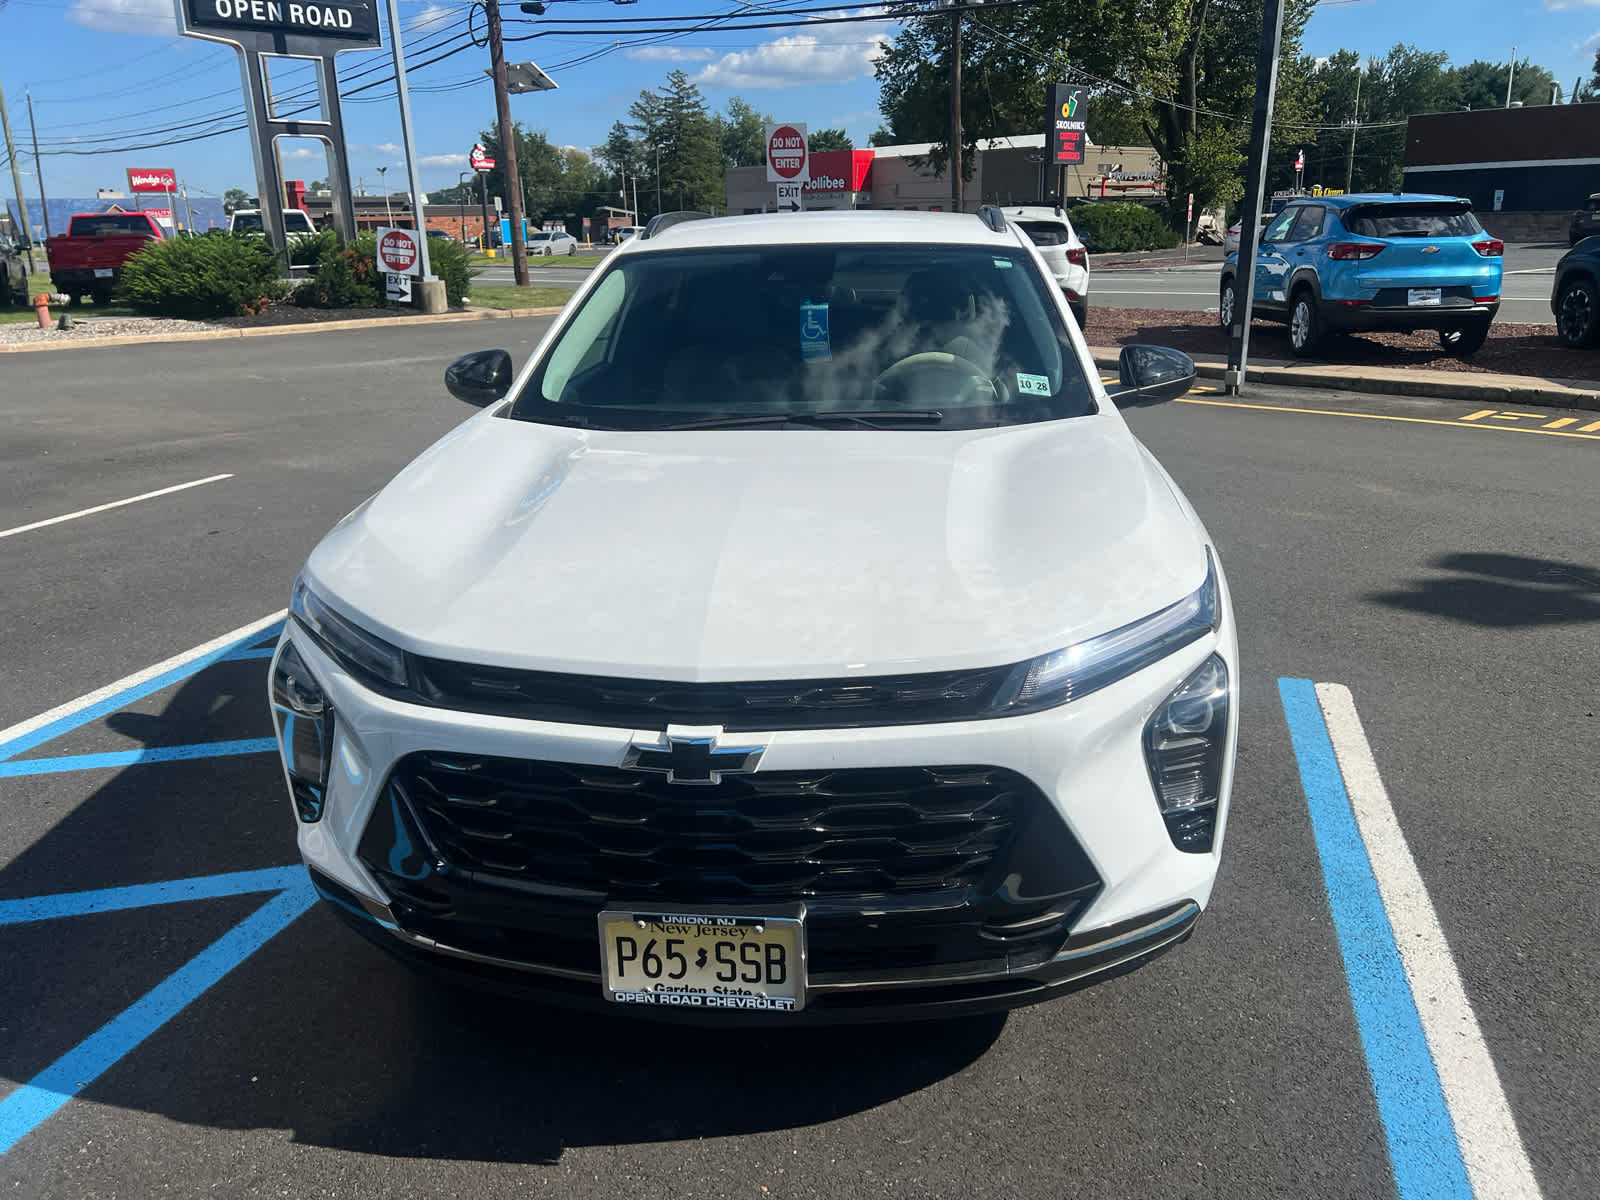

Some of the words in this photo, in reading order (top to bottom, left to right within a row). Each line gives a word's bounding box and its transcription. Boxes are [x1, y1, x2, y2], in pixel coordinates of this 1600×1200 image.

[215, 0, 283, 22] OPEN
[289, 3, 353, 28] ROAD
[1055, 120, 1086, 130] SKOLNIKS
[773, 137, 783, 147] DO
[786, 137, 801, 148] NOT
[775, 158, 801, 169] ENTER
[804, 175, 845, 190] Jollibee
[779, 187, 799, 198] EXIT
[383, 238, 395, 247] DO
[396, 239, 412, 249] NOT
[385, 254, 411, 265] ENTER
[388, 275, 409, 286] EXIT
[1020, 380, 1032, 389] 10
[1036, 382, 1048, 391] 28
[717, 918, 736, 926] NJ
[650, 923, 691, 935] New
[694, 924, 750, 939] Jersey
[615, 936, 688, 980] P65
[714, 941, 787, 985] SSB
[653, 983, 707, 995] Garden
[713, 985, 753, 997] State
[615, 992, 655, 1004] OPEN
[659, 994, 701, 1006] ROAD
[706, 996, 794, 1010] CHEVROLET
